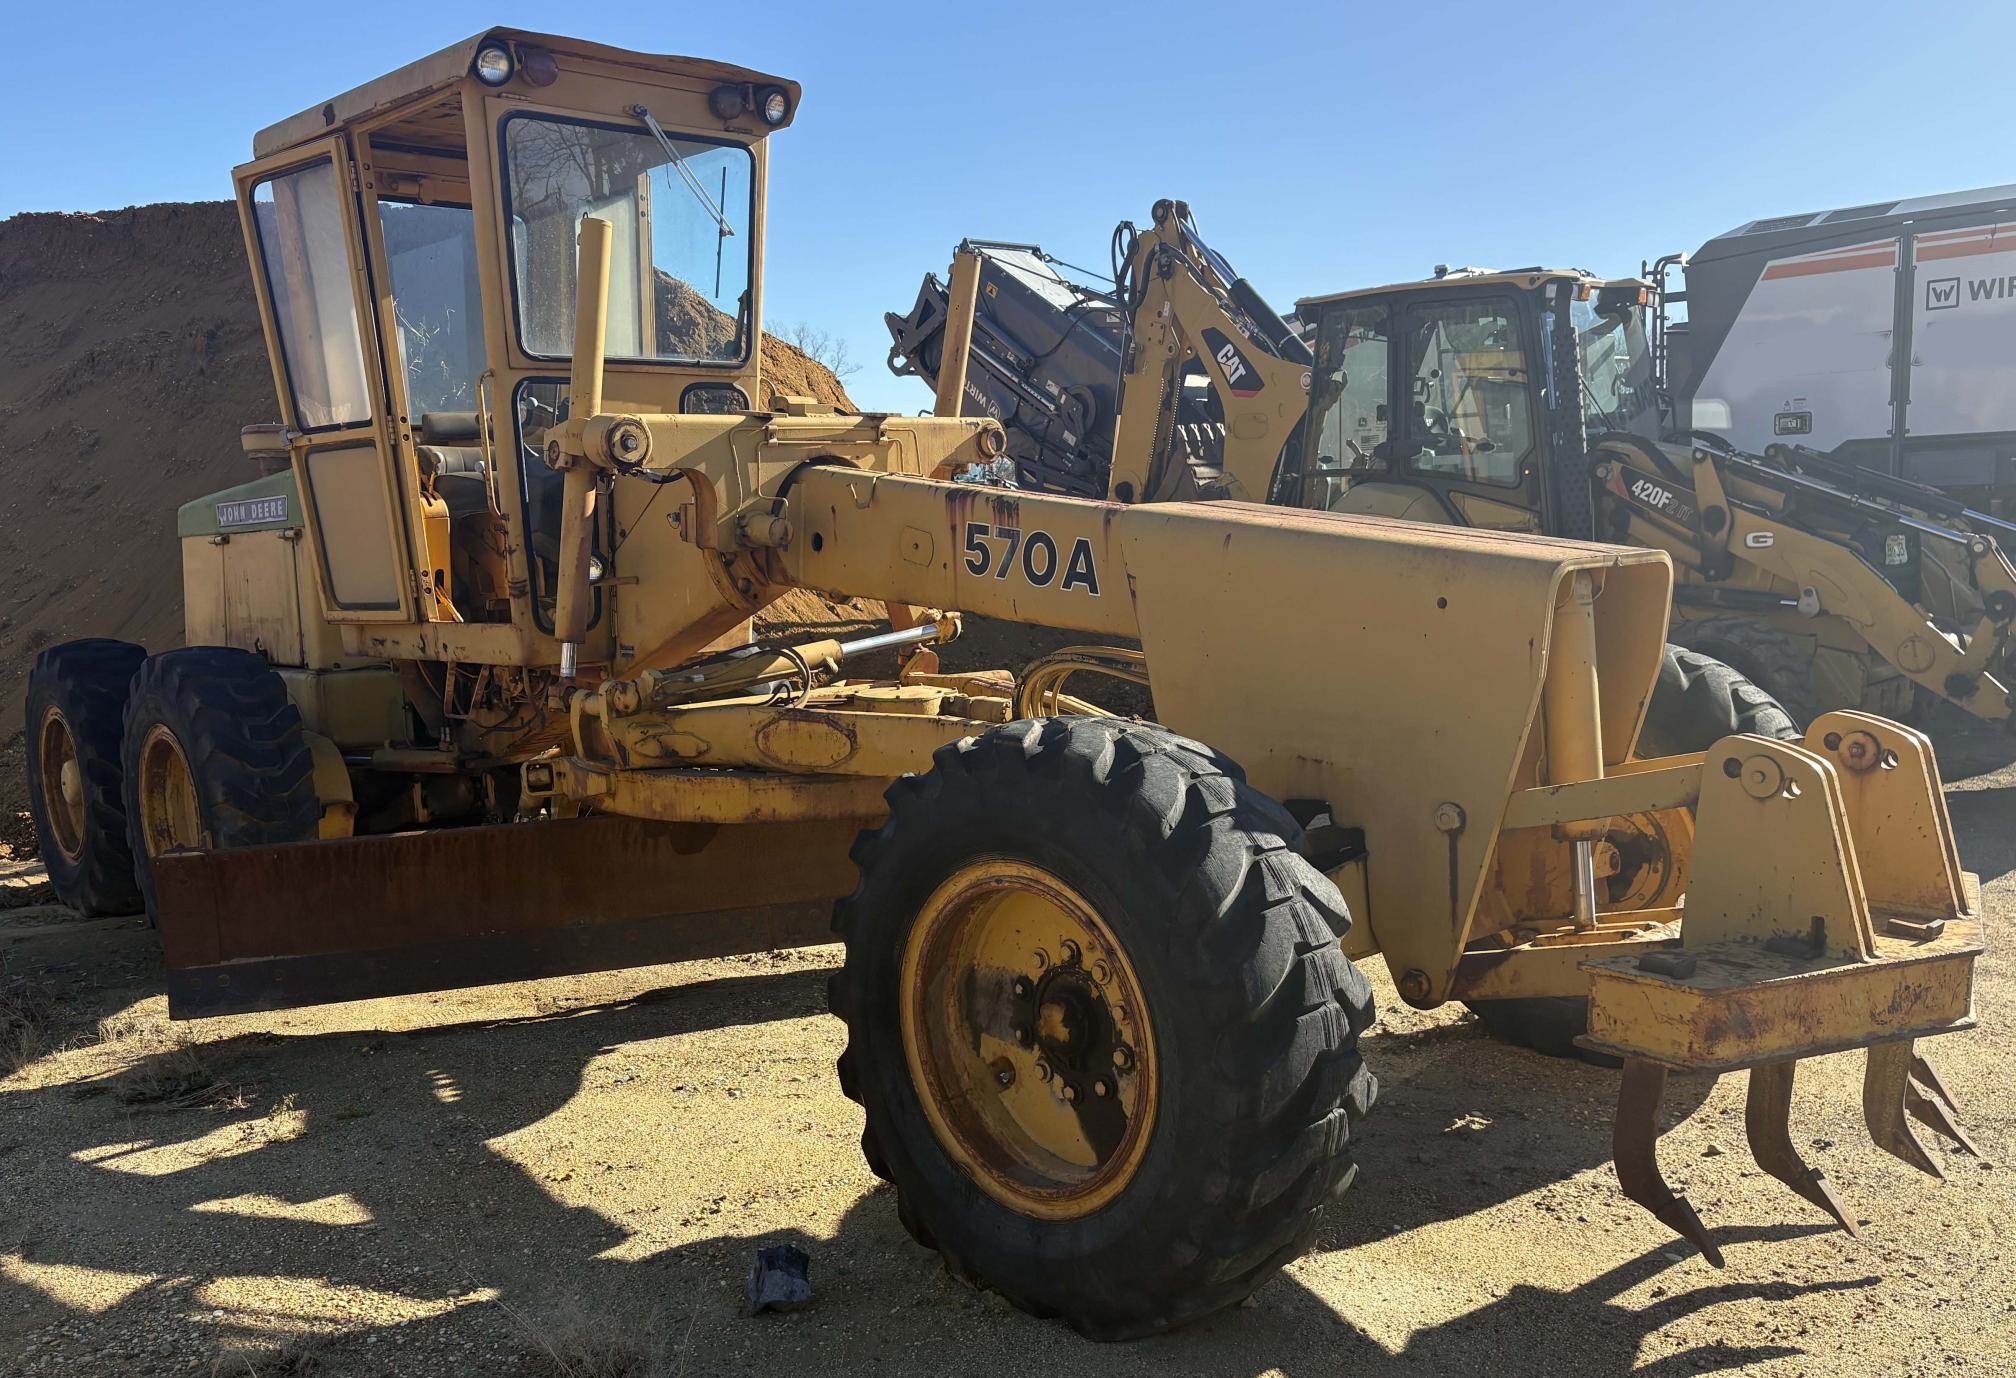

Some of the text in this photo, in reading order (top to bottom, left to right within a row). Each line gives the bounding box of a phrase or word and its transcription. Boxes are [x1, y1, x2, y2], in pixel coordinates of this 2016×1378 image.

[1931, 284, 1956, 303] W
[1217, 343, 1247, 385] CAT
[964, 380, 987, 408] WIRT
[222, 500, 283, 521] JOHN DEERE
[963, 521, 1101, 597] 570A
